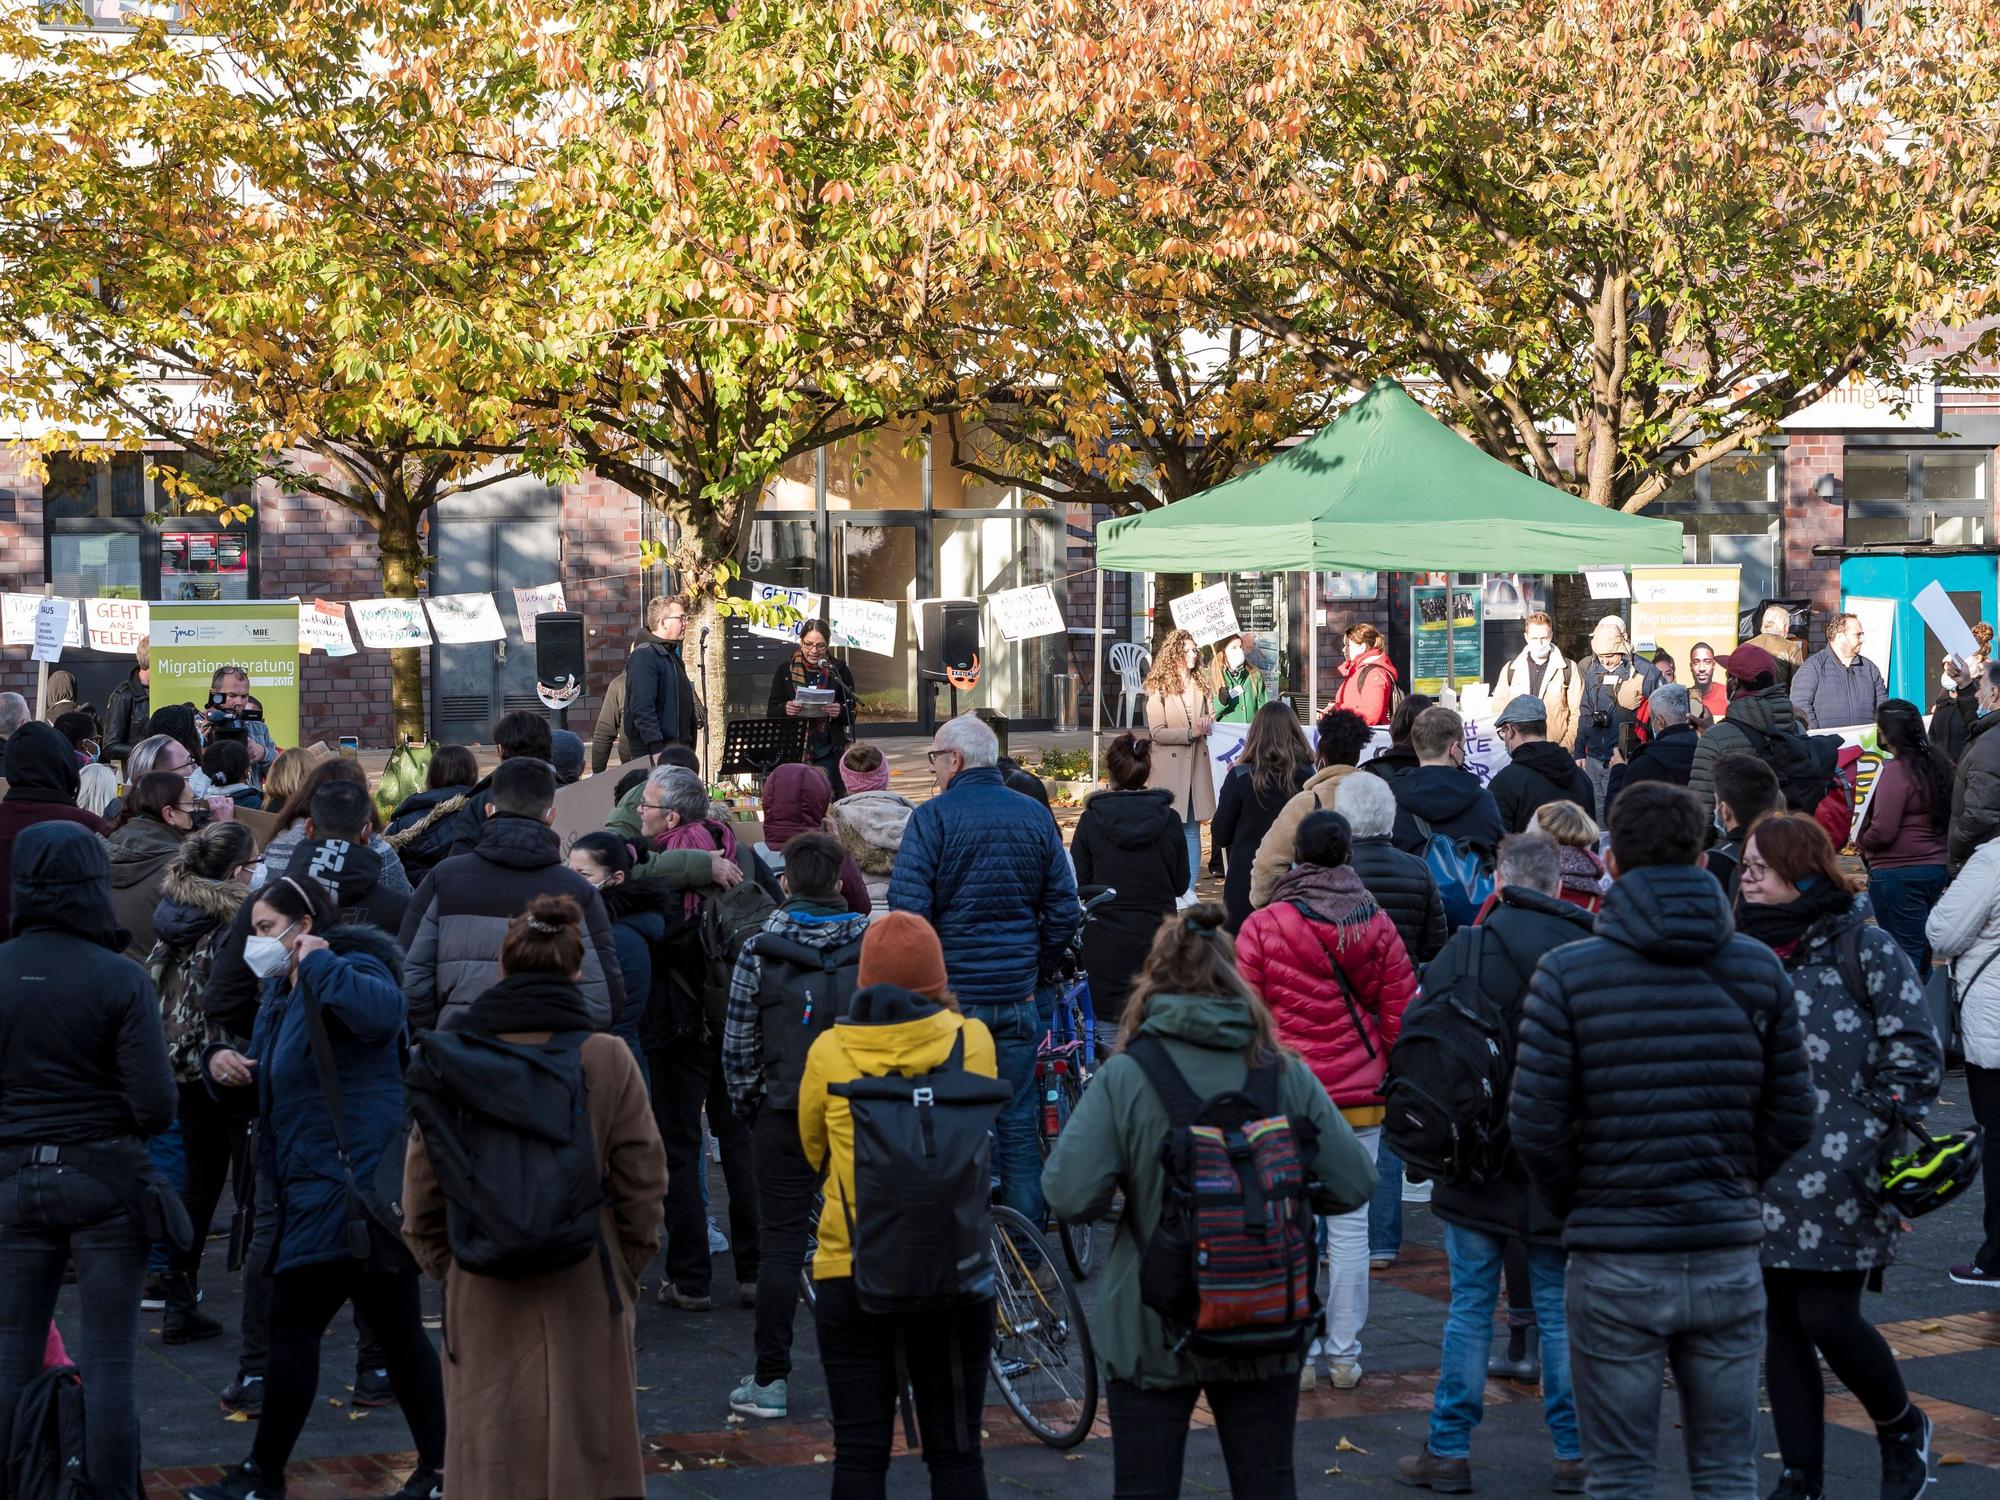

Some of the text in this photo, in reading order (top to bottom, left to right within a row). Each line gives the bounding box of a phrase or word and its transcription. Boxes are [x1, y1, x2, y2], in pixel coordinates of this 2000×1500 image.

[746, 551, 763, 573] 5
[96, 602, 143, 619] GEHT
[1177, 594, 1204, 613] KEINE
[1205, 611, 1225, 624] OHNE
[109, 621, 135, 630] ANS
[252, 628, 269, 636] MBE
